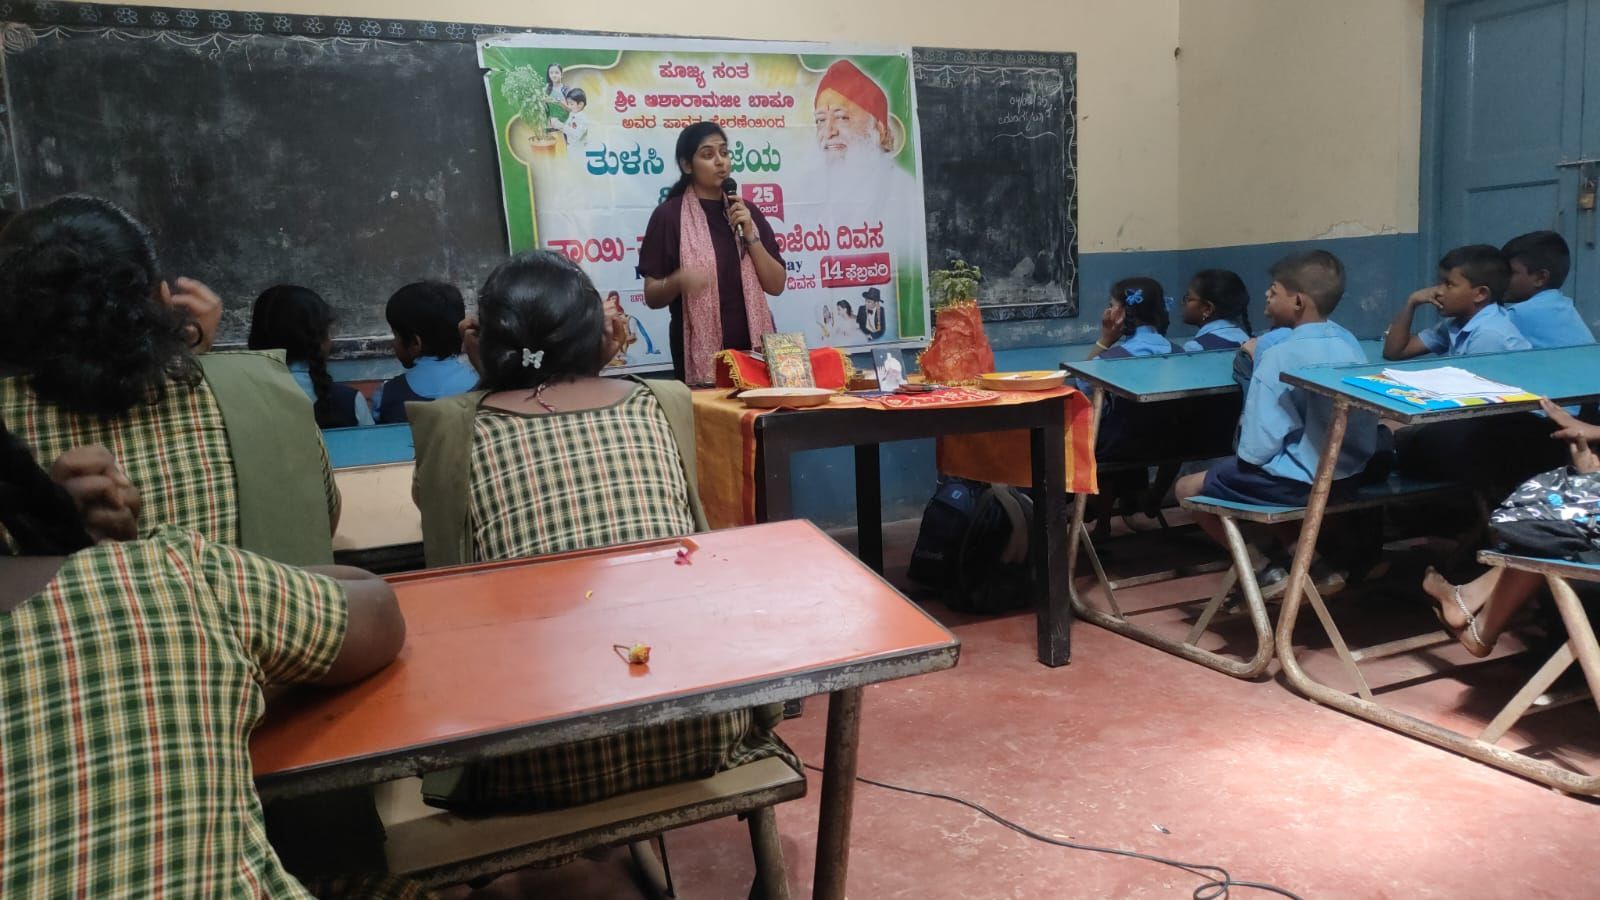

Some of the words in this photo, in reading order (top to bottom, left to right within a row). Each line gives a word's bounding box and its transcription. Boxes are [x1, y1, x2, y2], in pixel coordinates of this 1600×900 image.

[659, 61, 706, 88] ಪೂಜ್ಯ
[712, 61, 749, 79] ಸಂತ
[614, 90, 637, 112] ಶ್ರೀ
[748, 91, 795, 108] ಬಾಪೂ
[622, 115, 657, 129] ಅವರ
[586, 142, 665, 176] ತುಳಸಿ
[728, 140, 782, 173] ಜೆಯ
[752, 186, 775, 203] 25
[837, 220, 884, 250] ದಿವಸ
[786, 260, 803, 272] ay
[822, 261, 845, 281] 14
